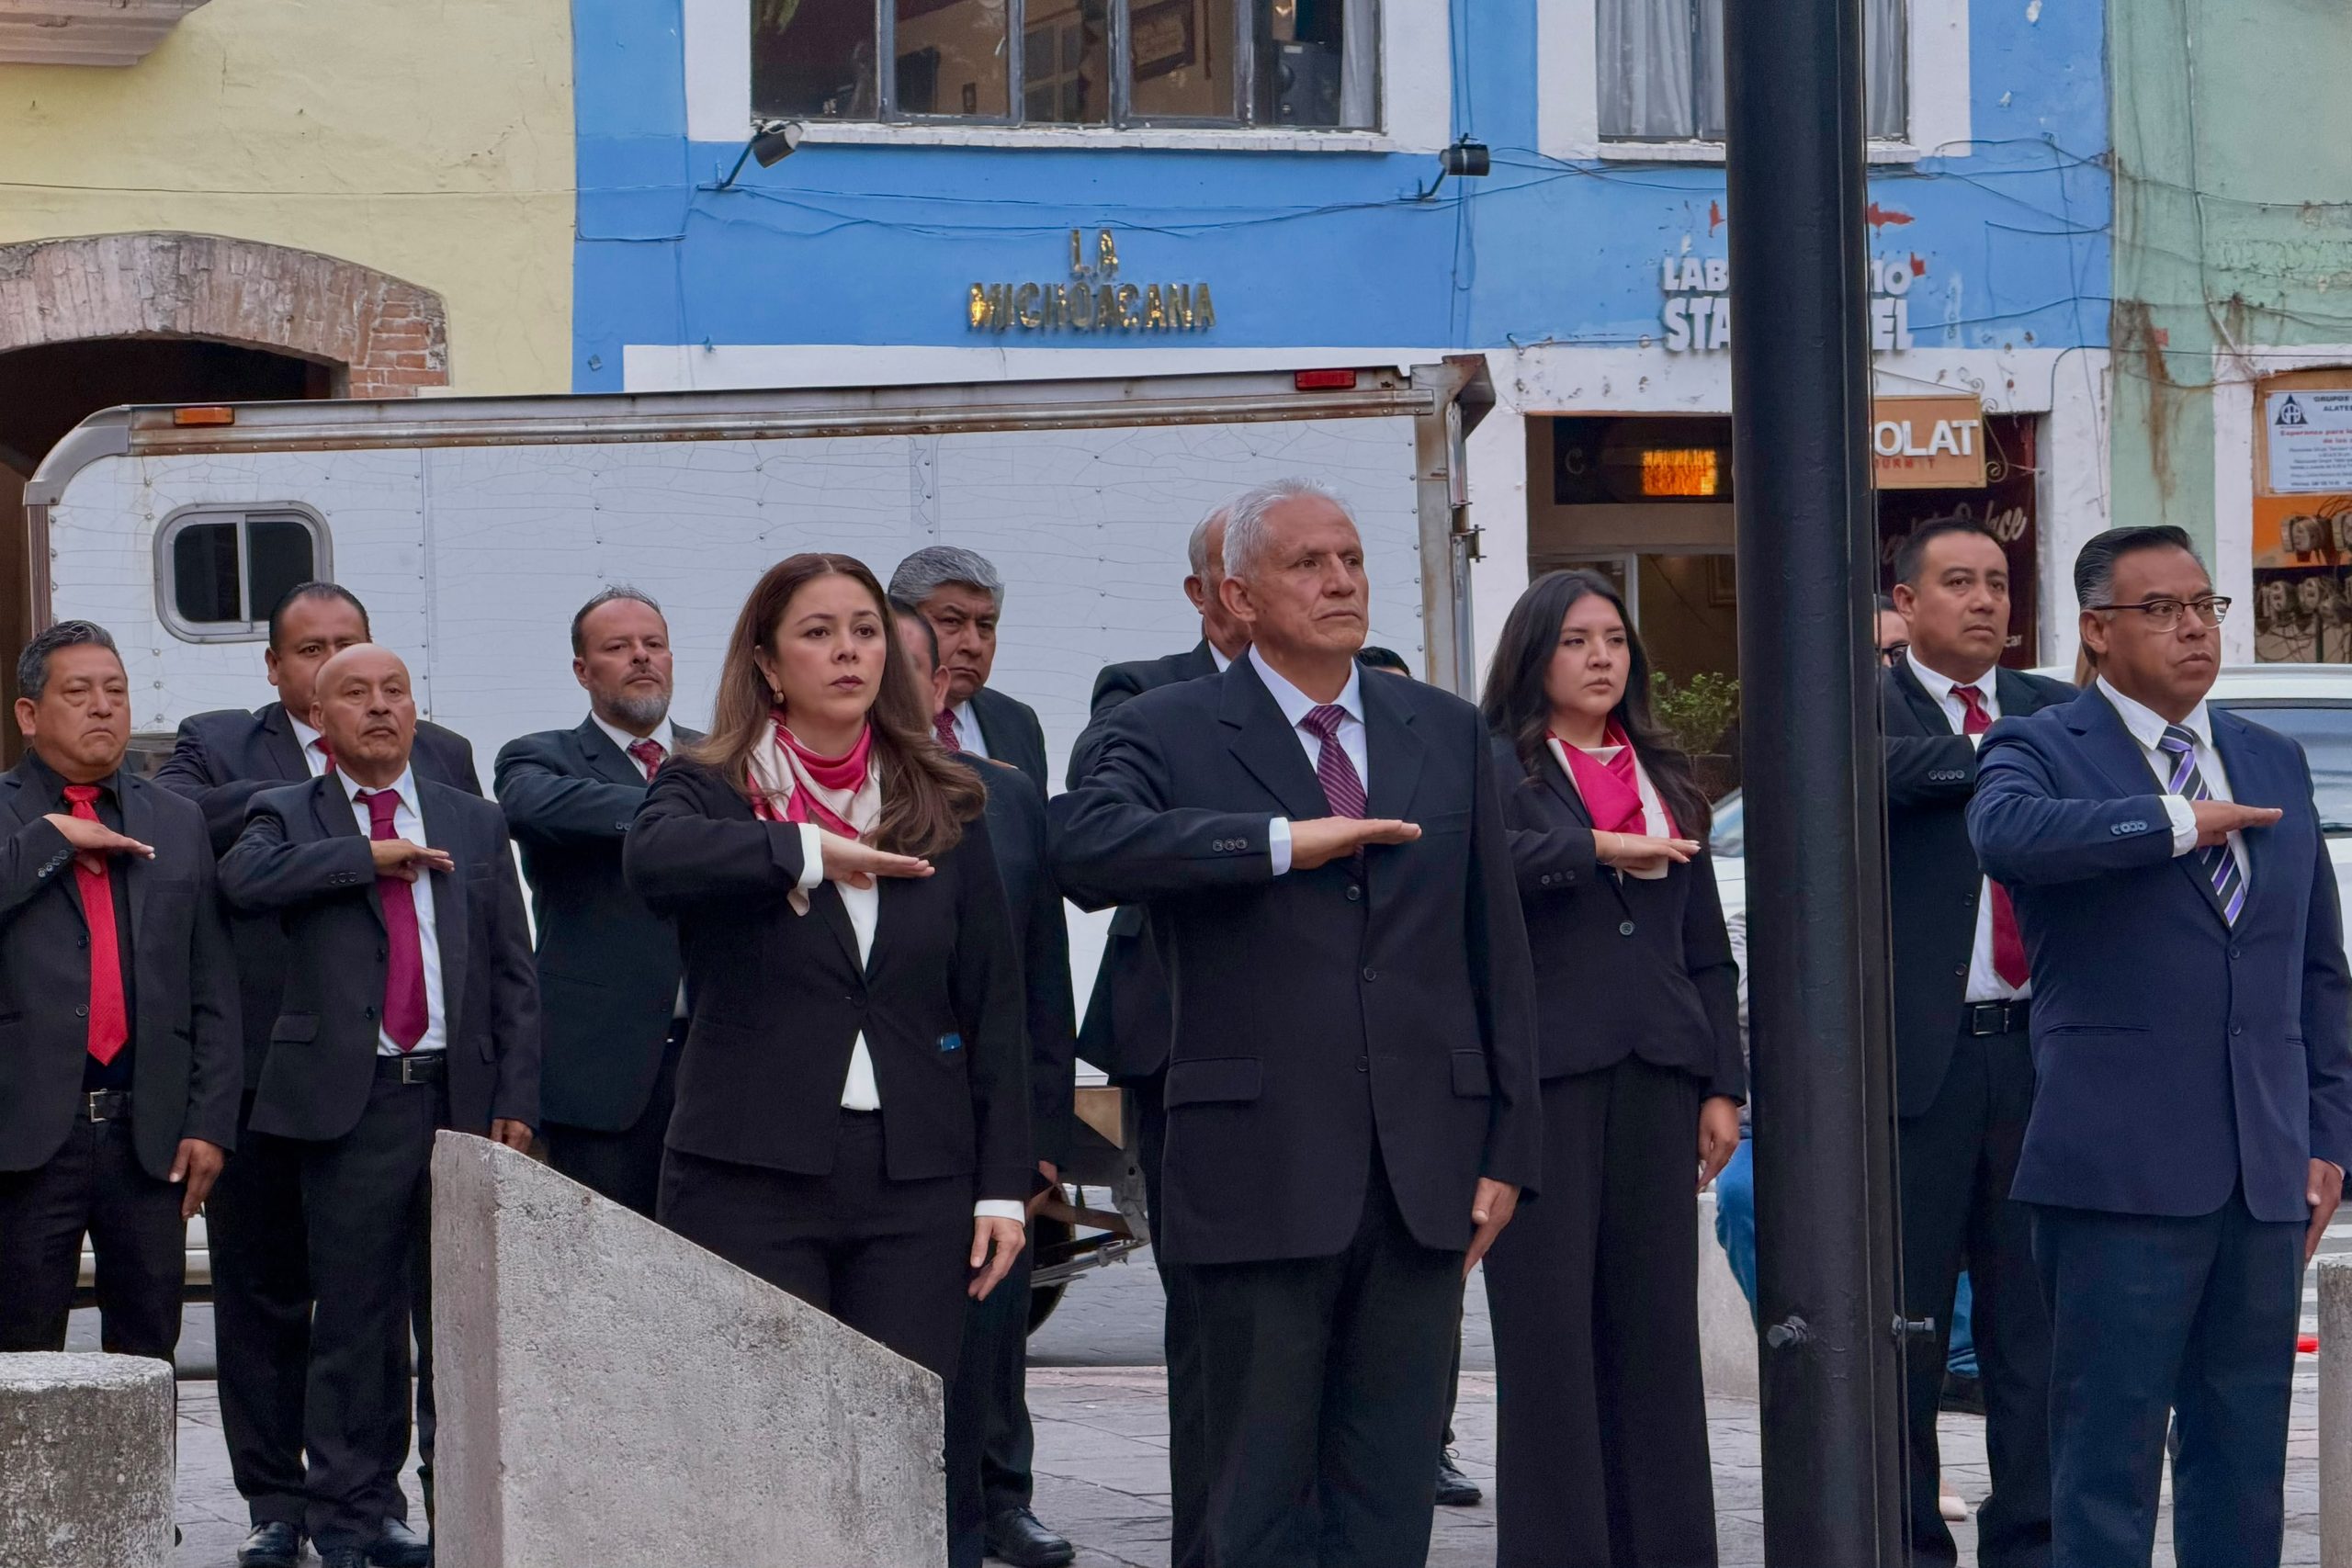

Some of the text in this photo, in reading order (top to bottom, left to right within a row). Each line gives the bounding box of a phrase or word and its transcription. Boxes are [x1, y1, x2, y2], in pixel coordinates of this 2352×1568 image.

[1071, 229, 1118, 275] LA
[969, 283, 1216, 328] MICHOACANA
[1874, 419, 1979, 457] OLAT
